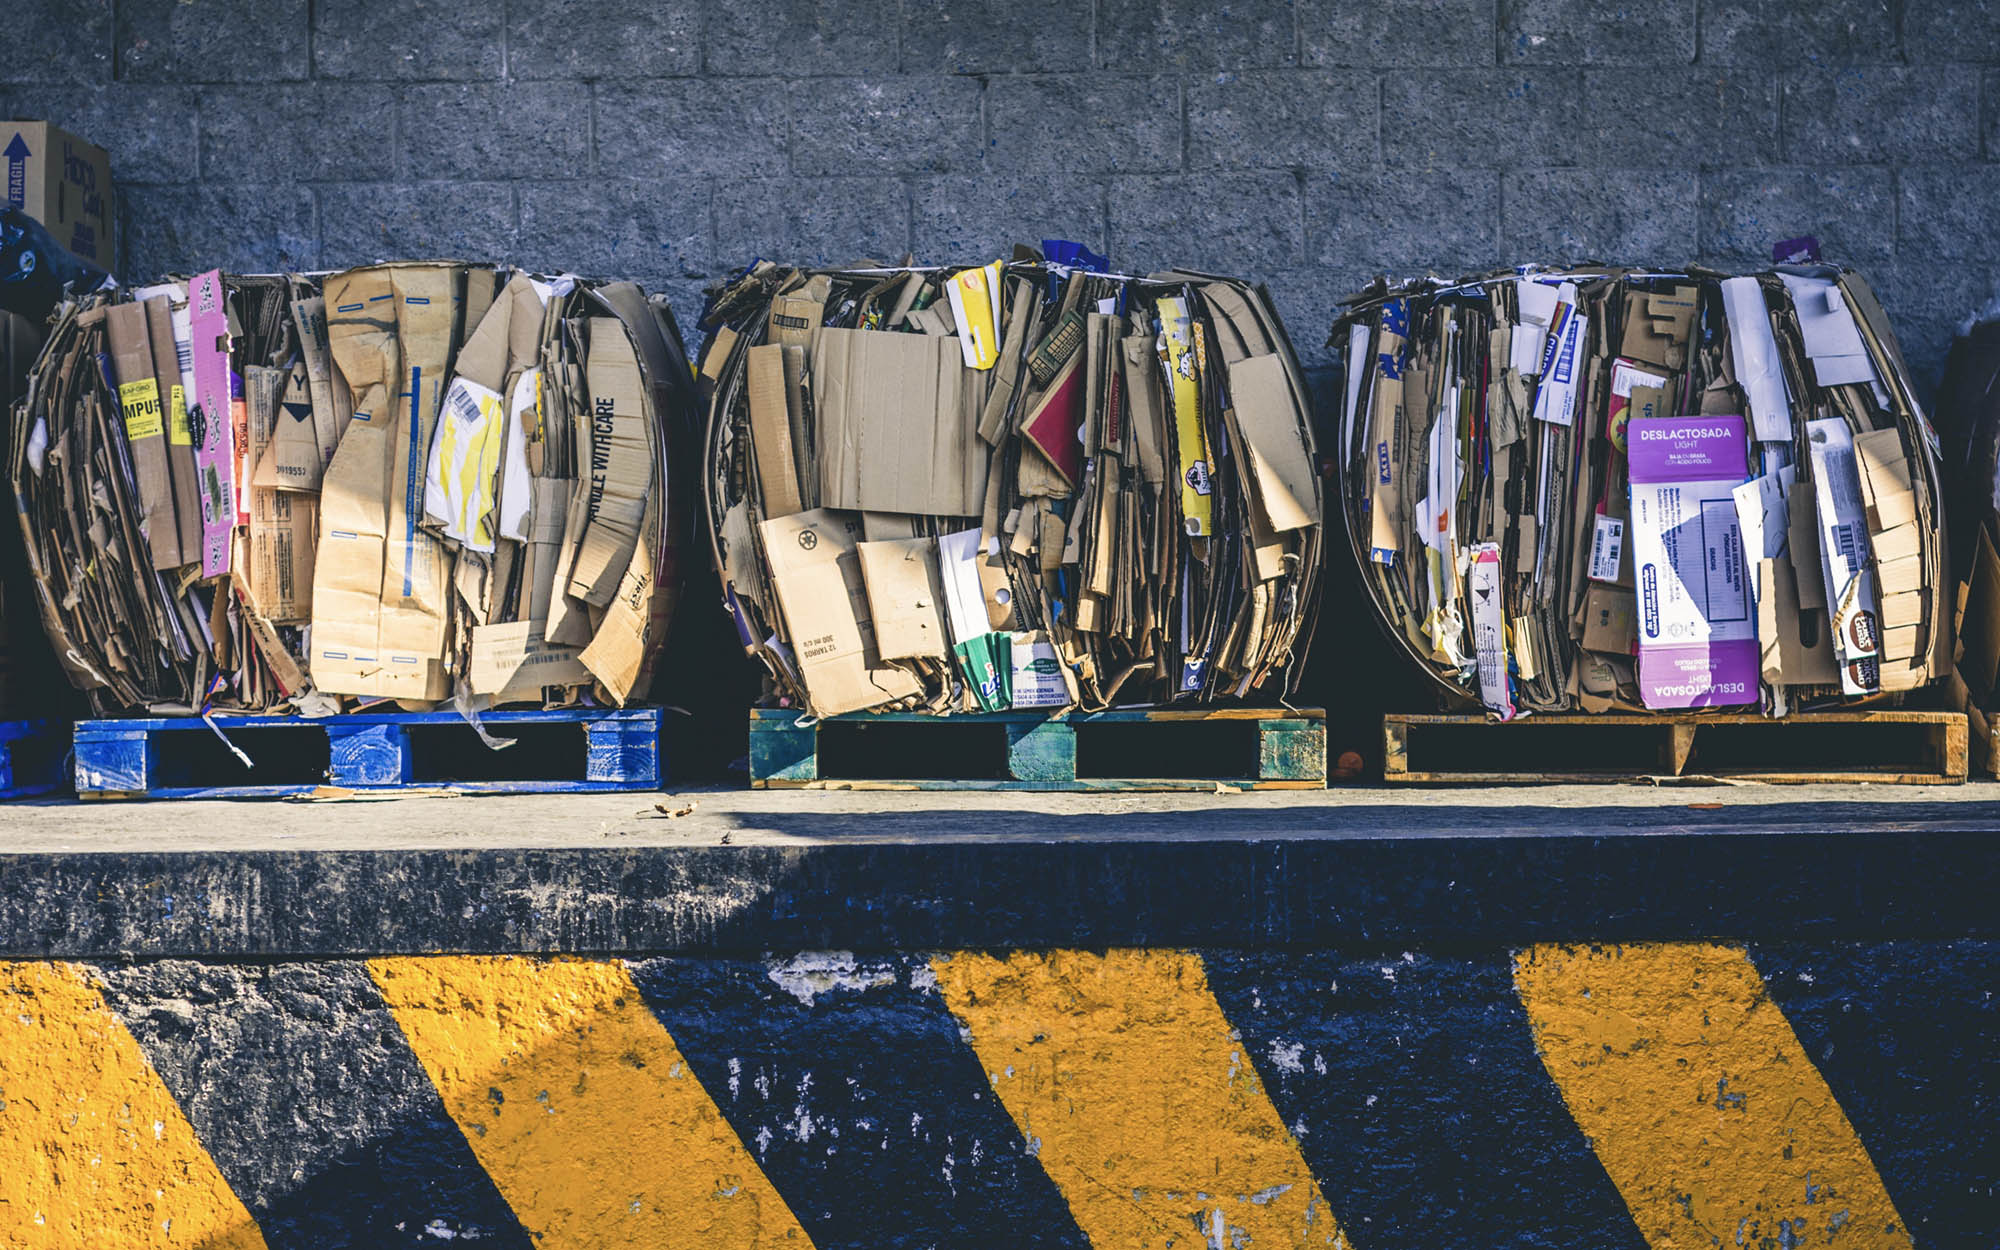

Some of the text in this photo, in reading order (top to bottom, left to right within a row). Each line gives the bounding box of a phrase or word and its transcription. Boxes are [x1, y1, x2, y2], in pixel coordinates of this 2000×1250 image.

[11, 160, 23, 201] FRAGIL
[596, 397, 614, 434] CARE
[1641, 428, 1731, 440] DESLACTOSADA
[1674, 440, 1698, 449] LIGHT
[1854, 617, 1865, 648] Gusto
[804, 644, 836, 659] 12 TARROS
[1654, 682, 1745, 698] DESLACTOSADA
